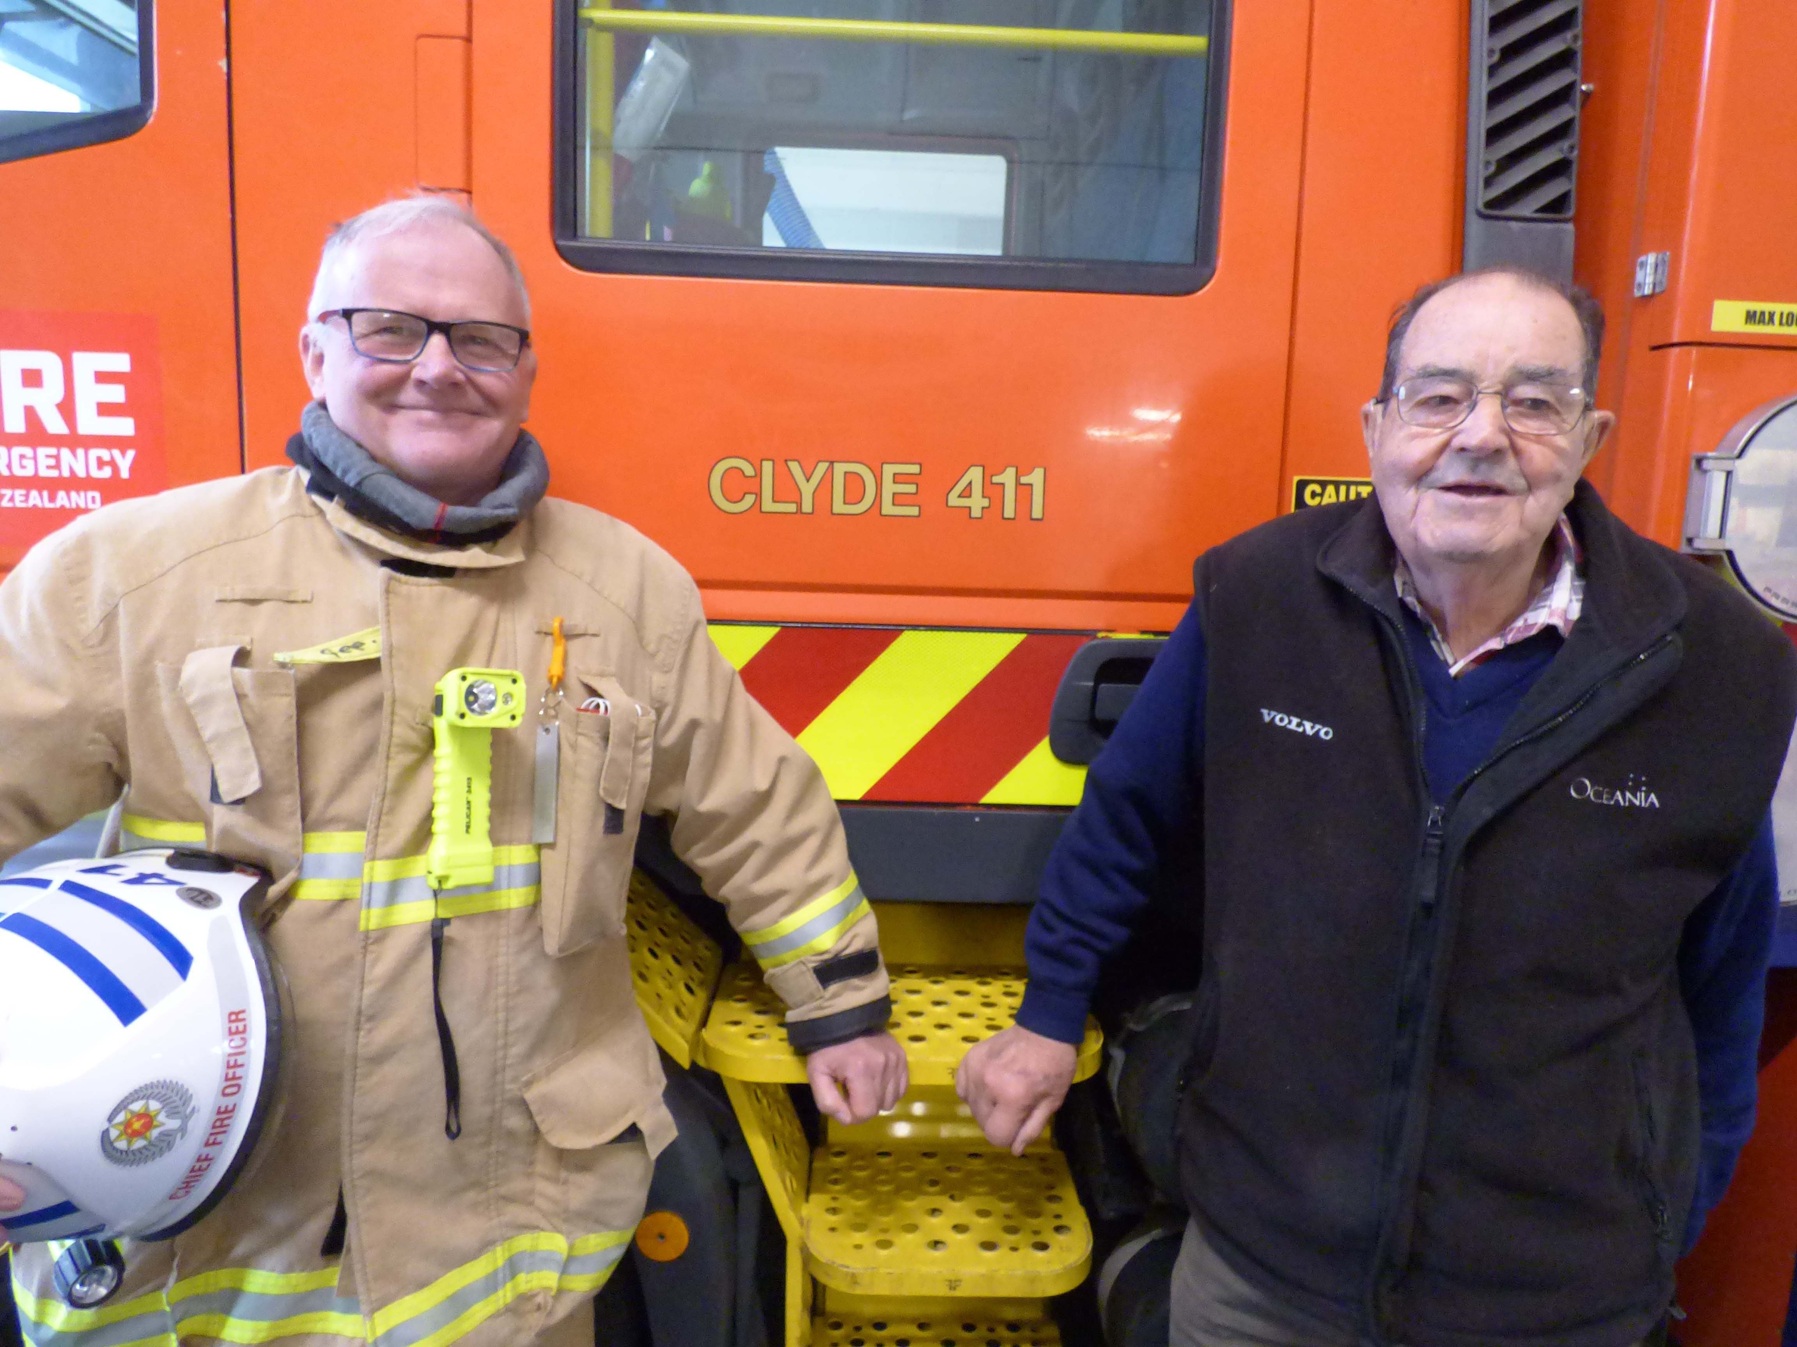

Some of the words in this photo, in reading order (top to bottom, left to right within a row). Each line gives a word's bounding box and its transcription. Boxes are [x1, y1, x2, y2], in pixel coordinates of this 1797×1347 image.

[1745, 309, 1776, 326] MAX
[1779, 311, 1797, 327] LO
[0, 349, 136, 436] RE
[0, 489, 101, 510] ZEALAND
[708, 456, 922, 517] CLYDE
[946, 465, 1046, 521] 411
[1260, 708, 1334, 740] VOLVO
[1570, 775, 1660, 808] OCEANIA
[168, 1152, 215, 1200] CHIEF
[204, 1102, 237, 1148] FIRE
[221, 1008, 248, 1098] OFFICER
